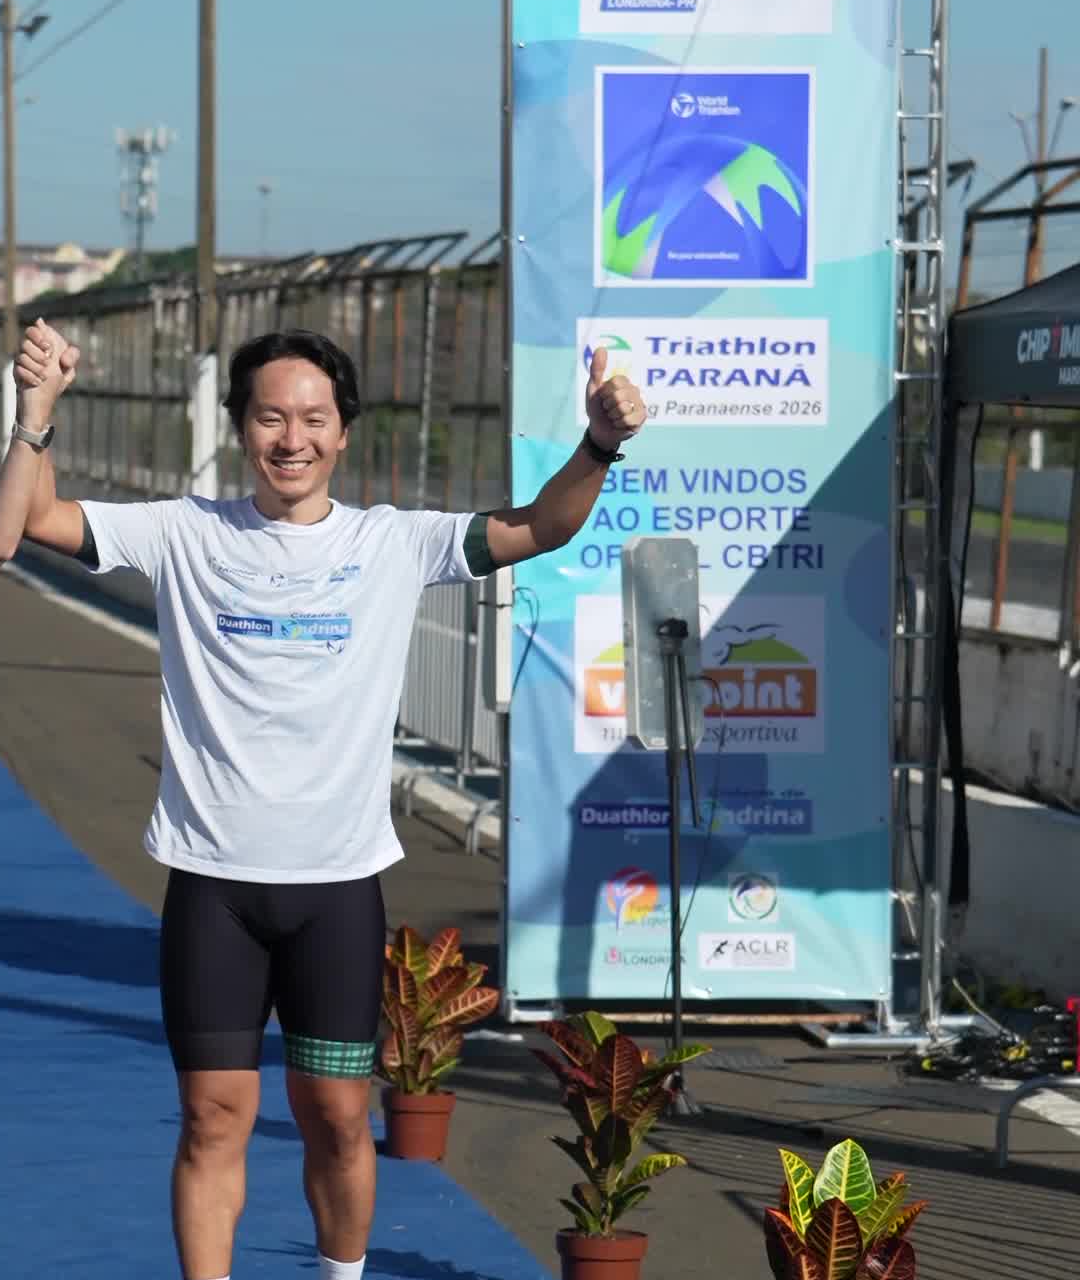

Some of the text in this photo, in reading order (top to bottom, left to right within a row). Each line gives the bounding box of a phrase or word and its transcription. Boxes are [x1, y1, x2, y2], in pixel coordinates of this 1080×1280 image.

[645, 336, 816, 356] Triathlon
[665, 401, 773, 416] Paranaense
[779, 401, 822, 416] 2026
[601, 468, 807, 494] BEM VINDOS
[593, 506, 811, 531] AO ESPORTE
[723, 544, 825, 569] CBTRI
[218, 616, 271, 632] Duathlon
